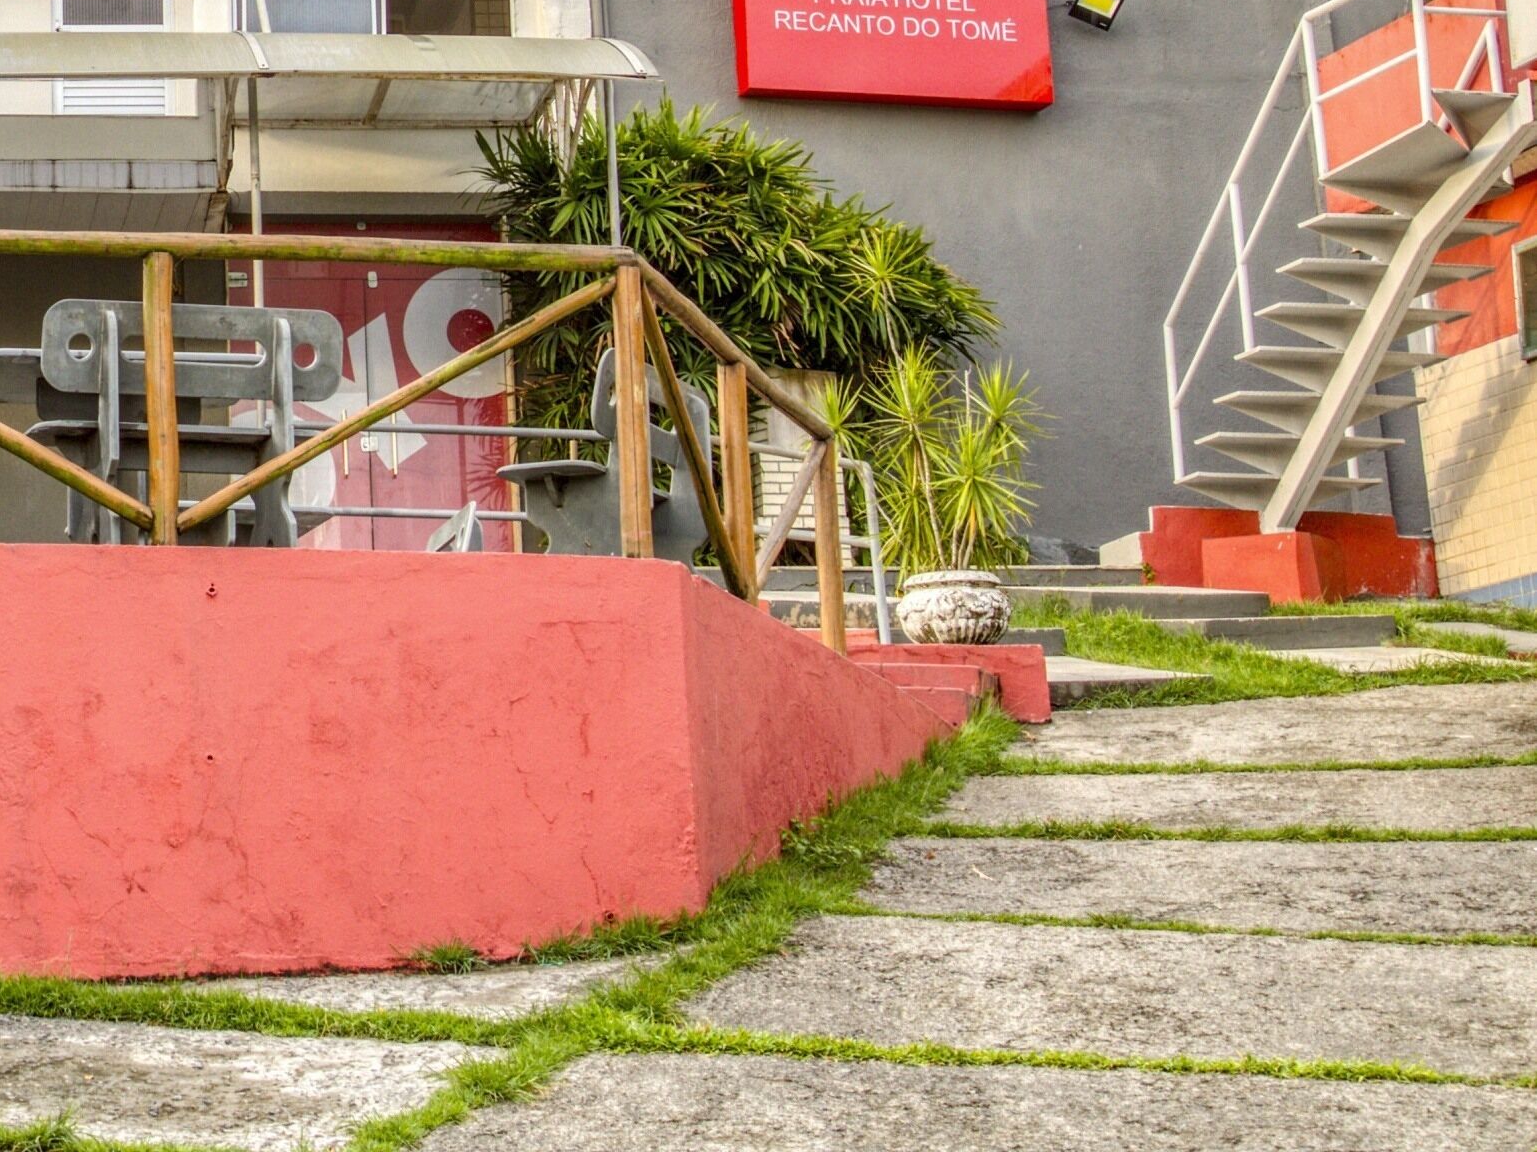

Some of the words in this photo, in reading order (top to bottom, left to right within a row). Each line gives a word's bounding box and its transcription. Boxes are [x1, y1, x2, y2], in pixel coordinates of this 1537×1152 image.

[774, 10, 895, 35] RECANTO
[903, 16, 940, 37] DO
[946, 18, 1017, 42] TOMÉ
